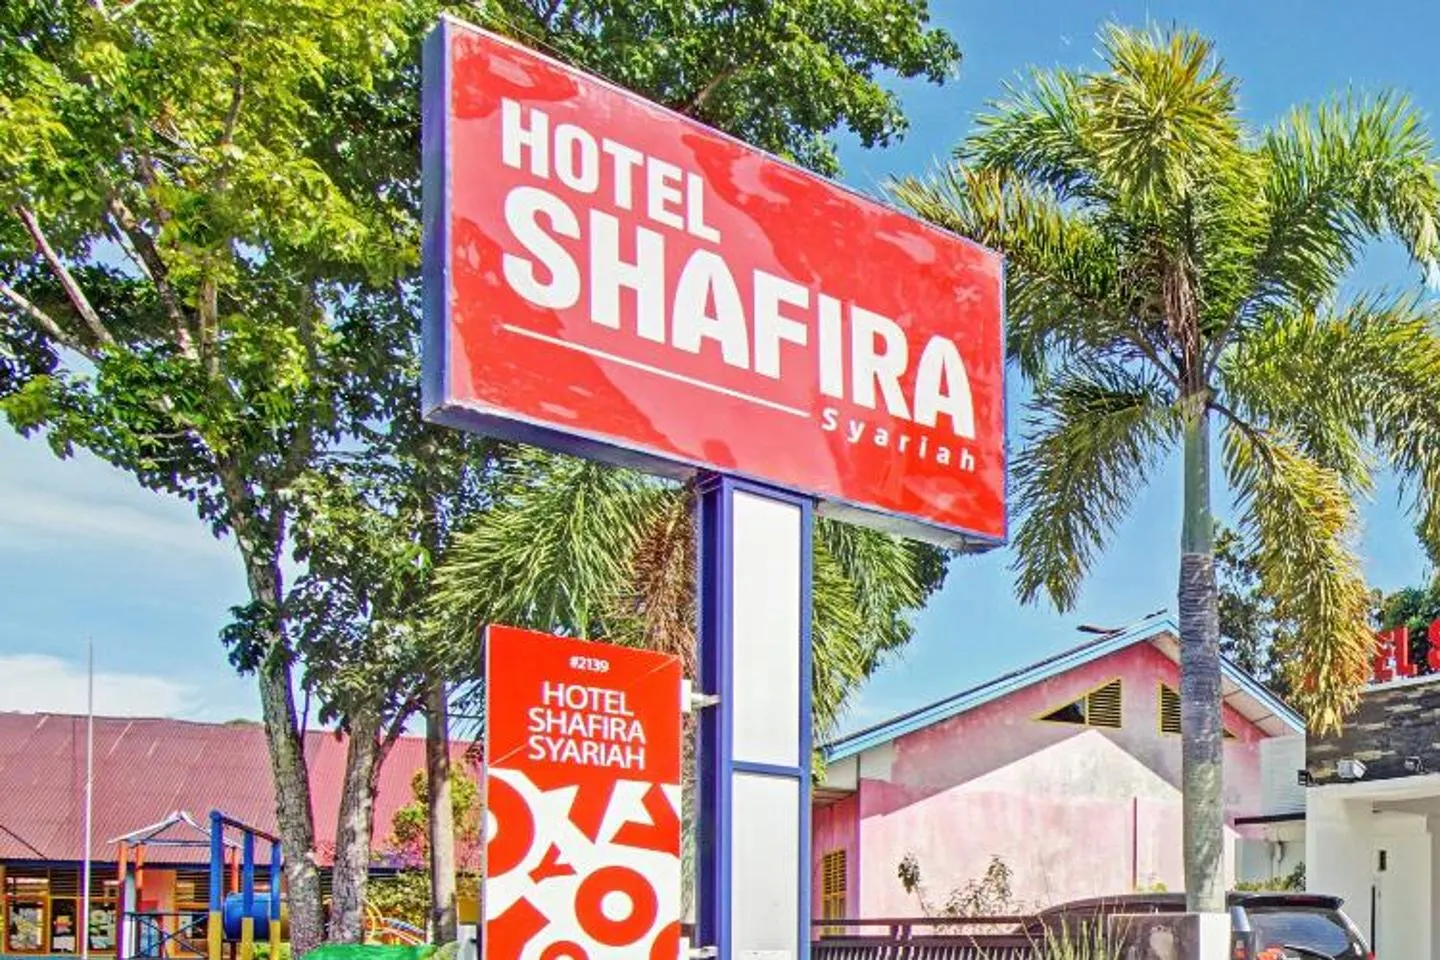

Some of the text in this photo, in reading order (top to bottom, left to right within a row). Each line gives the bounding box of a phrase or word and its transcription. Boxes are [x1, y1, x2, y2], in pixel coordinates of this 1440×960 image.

[501, 98, 721, 244] HOTEL
[502, 185, 976, 440] SHAFIRA
[821, 406, 976, 474] Syariah
[568, 655, 610, 673] #2139
[541, 680, 635, 717] HOTEL
[527, 706, 647, 745] SHAFIRA
[527, 734, 646, 770] SYARIAH
